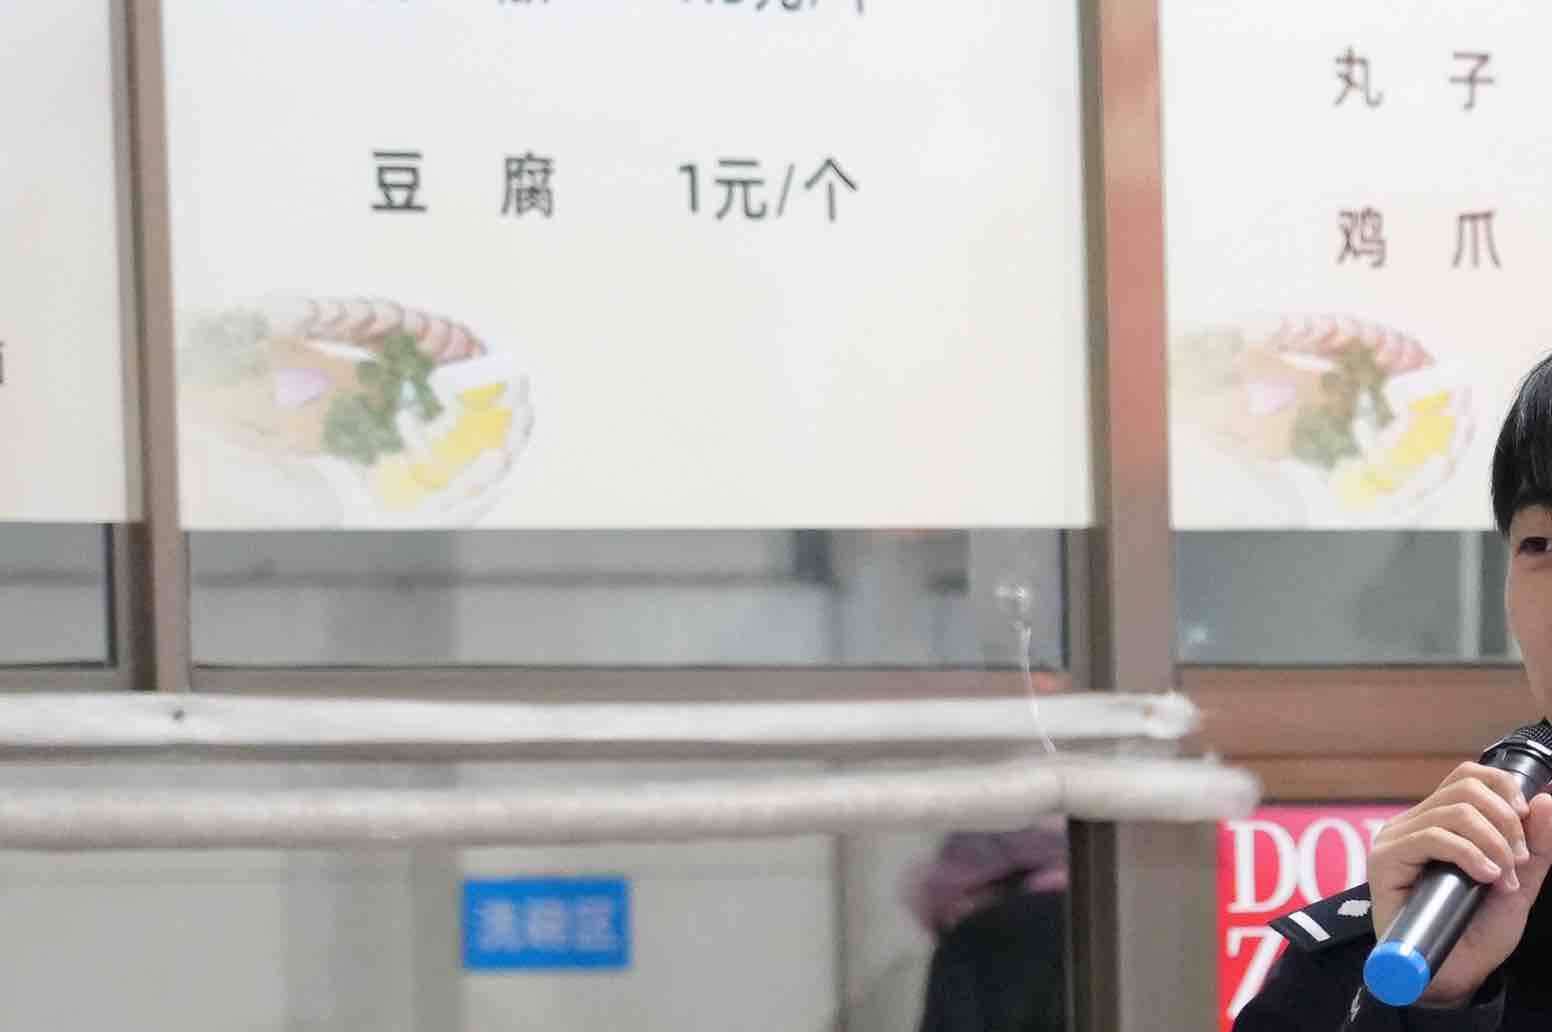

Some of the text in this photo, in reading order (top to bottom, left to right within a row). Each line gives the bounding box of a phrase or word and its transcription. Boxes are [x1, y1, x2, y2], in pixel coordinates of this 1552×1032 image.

[1335, 48, 1495, 110] 丸子
[370, 151, 858, 222] 豆腐 1元/个
[1338, 207, 1501, 269] 鸡爪
[1225, 817, 1390, 913] DO
